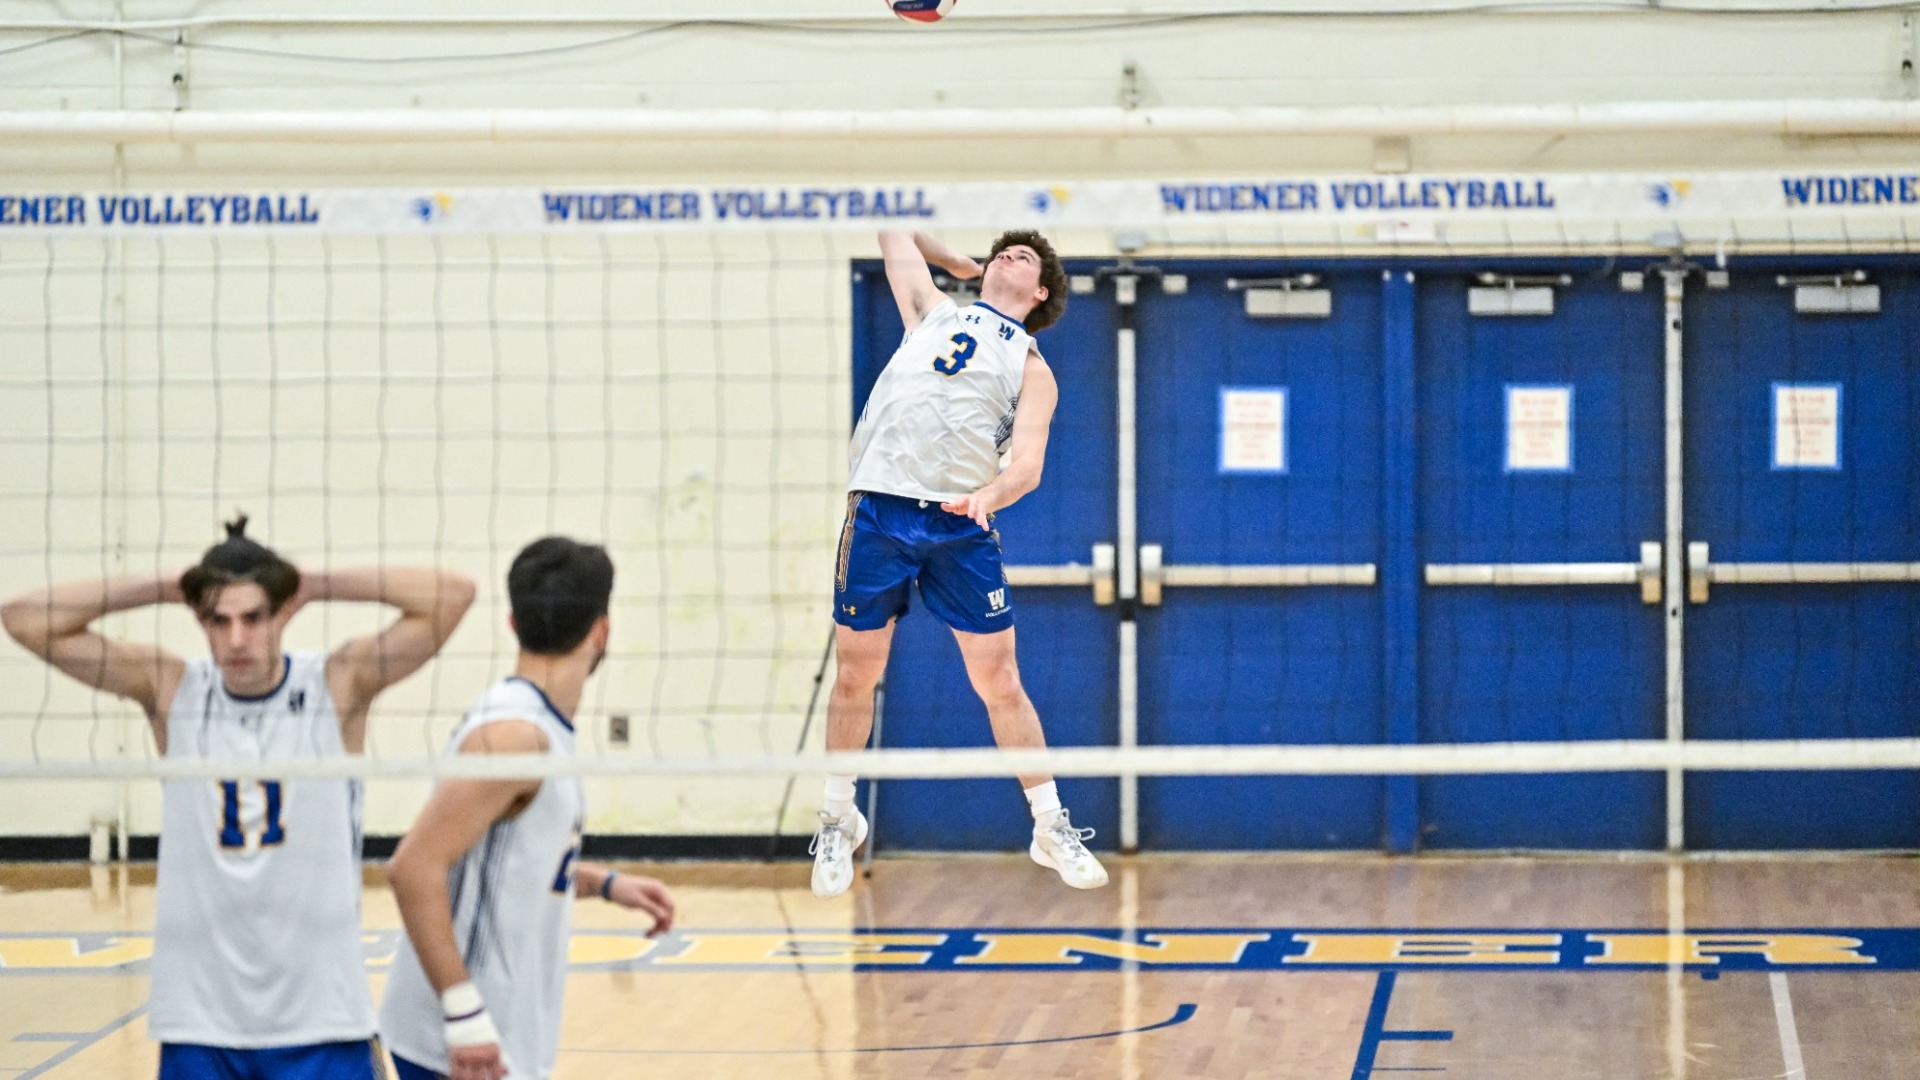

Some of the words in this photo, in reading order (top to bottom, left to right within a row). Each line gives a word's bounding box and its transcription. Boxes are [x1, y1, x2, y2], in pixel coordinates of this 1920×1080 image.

[542, 191, 701, 223] WIDENER
[711, 189, 936, 220] VOLLEYBALL
[1159, 182, 1319, 214] WIDENER
[1329, 178, 1556, 210] VOLLEYBALL
[1781, 174, 1920, 207] WIDENE
[98, 194, 320, 225] VOLLEYBALL
[931, 331, 979, 377] 3
[987, 587, 1005, 611] W
[216, 777, 286, 849] 11
